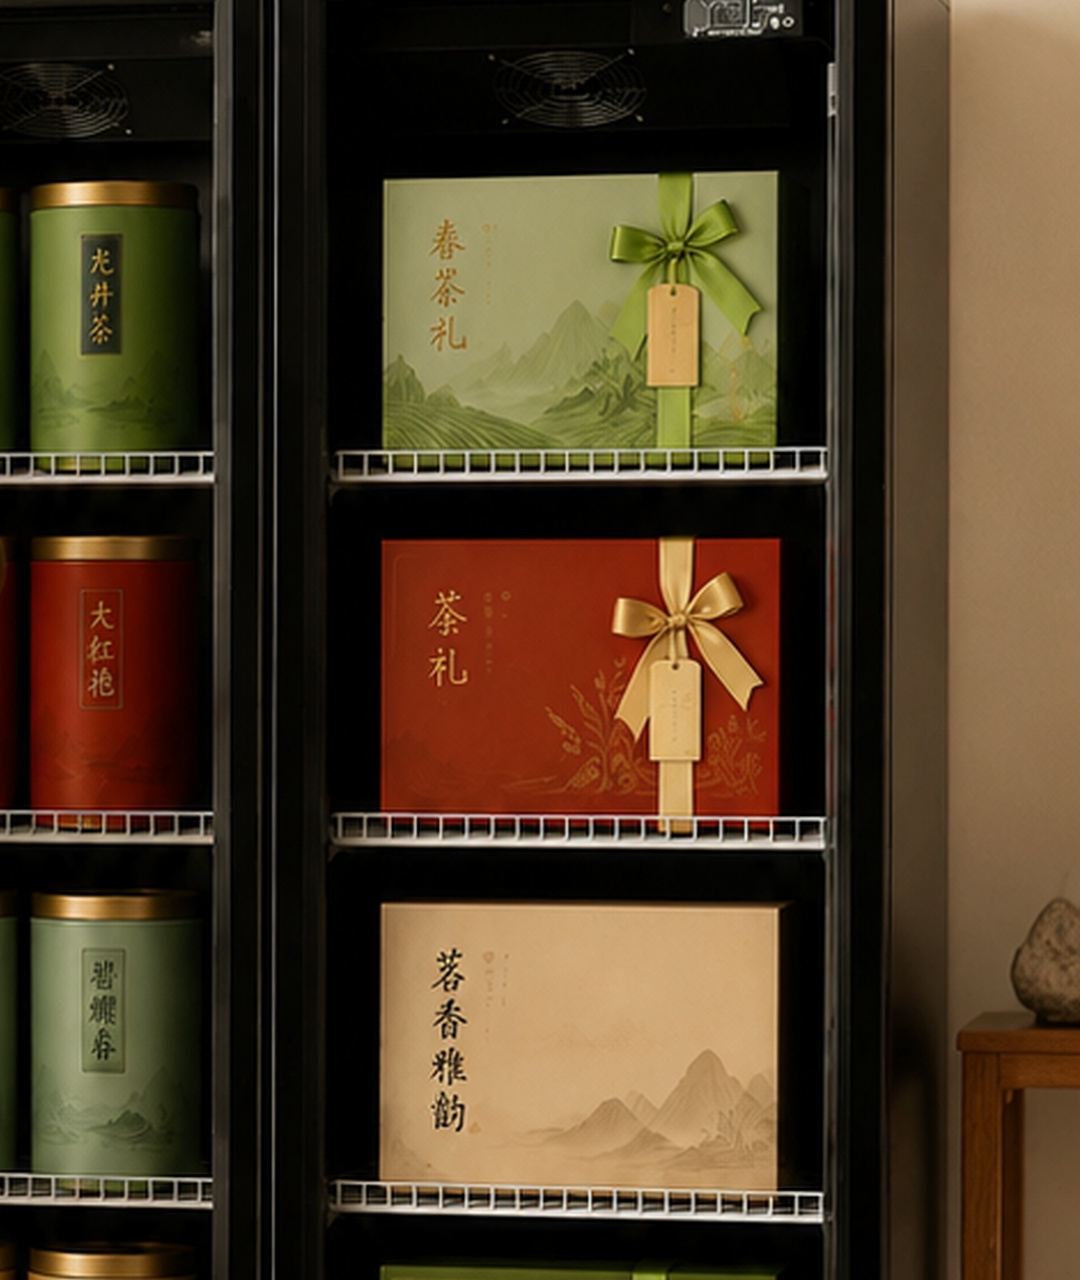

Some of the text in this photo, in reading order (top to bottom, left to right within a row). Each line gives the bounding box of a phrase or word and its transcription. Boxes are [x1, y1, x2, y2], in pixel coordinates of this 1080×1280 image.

[89, 247, 115, 344] 龙井茶
[429, 219, 467, 352] 春茶礼
[86, 600, 115, 698] 大红袍
[428, 590, 468, 687] 茶礼
